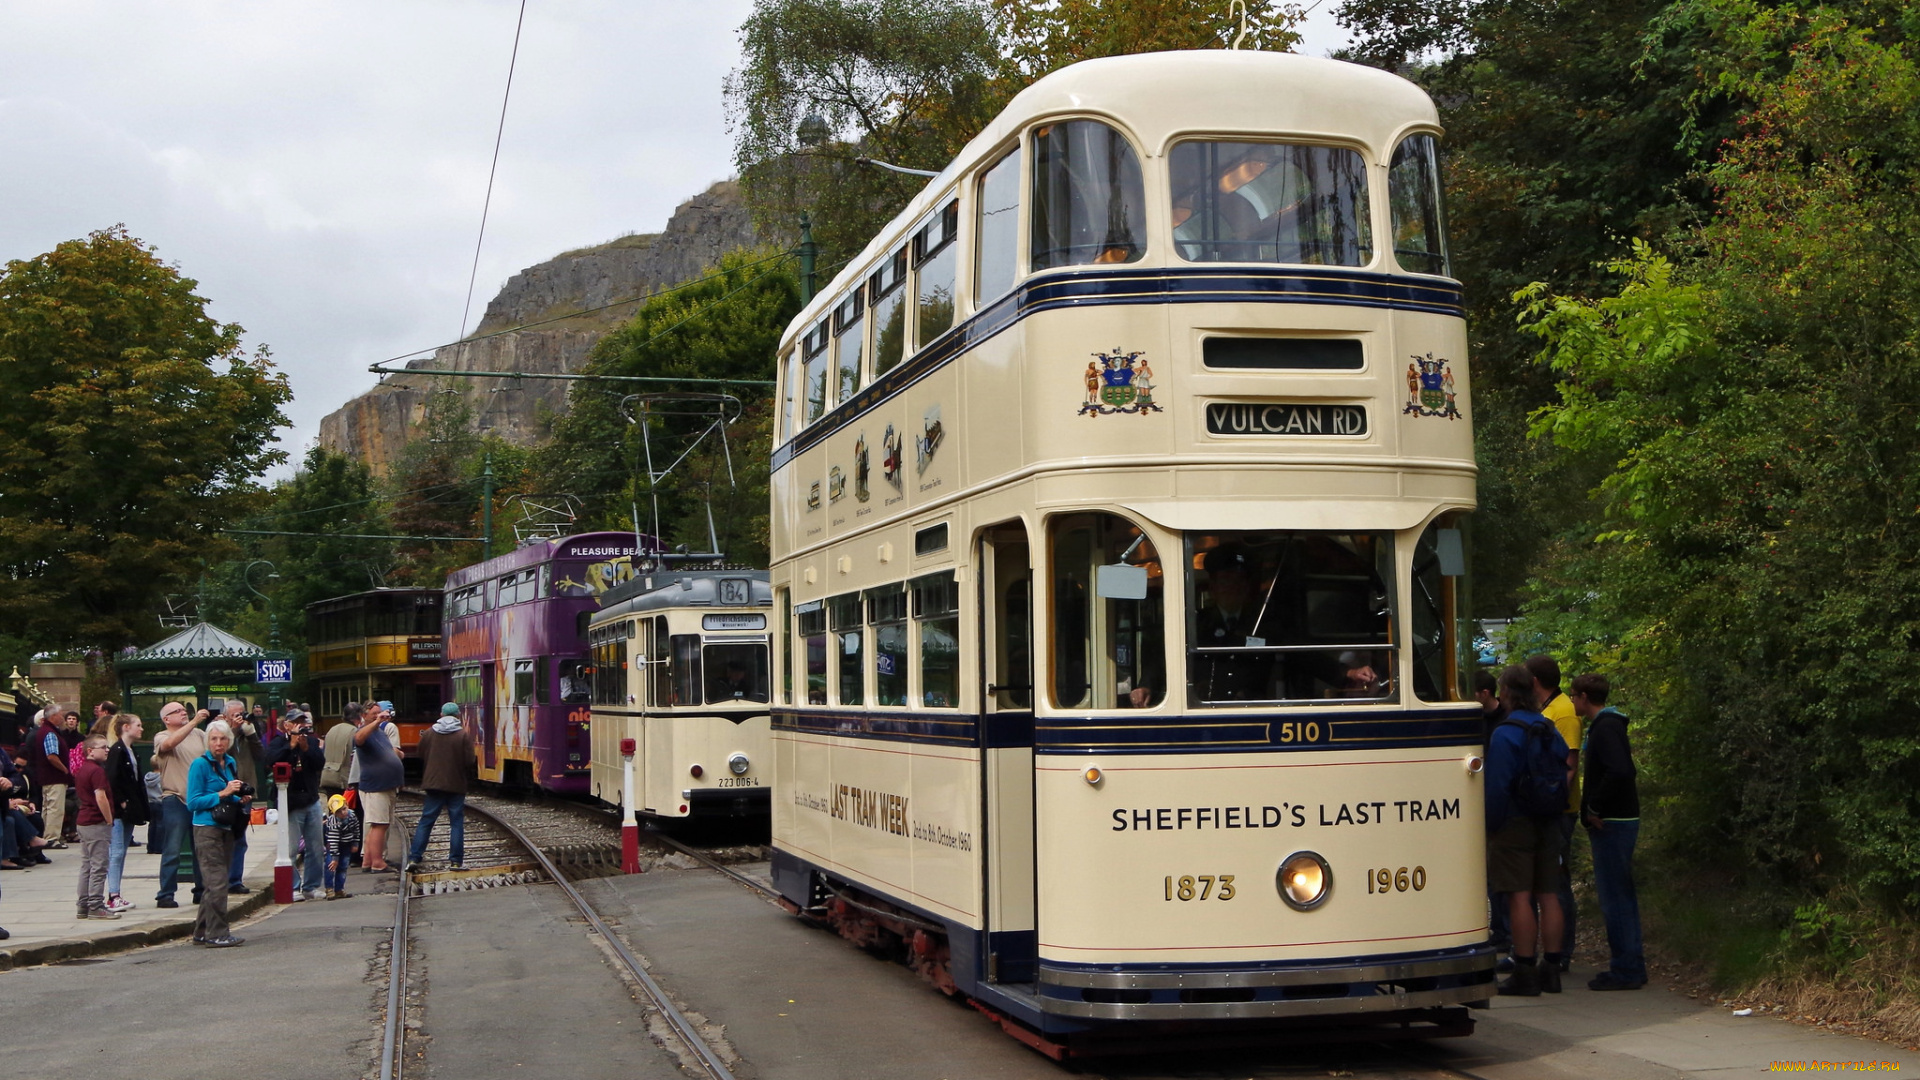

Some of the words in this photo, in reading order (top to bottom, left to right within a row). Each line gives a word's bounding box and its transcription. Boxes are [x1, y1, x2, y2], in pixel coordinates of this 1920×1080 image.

[1209, 405, 1322, 433] VULCAN
[1332, 407, 1362, 434] RD
[571, 547, 620, 556] PLEASURE
[261, 663, 287, 678] STOP
[1280, 721, 1320, 743] 510
[719, 778, 734, 788] 223
[736, 777, 758, 787] 006-4
[830, 782, 849, 821] LAST
[851, 786, 877, 829] TRAM
[880, 791, 910, 838] WEEK
[1112, 802, 1306, 832] SHEFFIELD'S
[1319, 802, 1386, 826] LAST
[1393, 798, 1460, 822] TRAM
[958, 831, 972, 852] 1960
[1164, 875, 1237, 901] 1873
[1367, 865, 1427, 895] 1960
